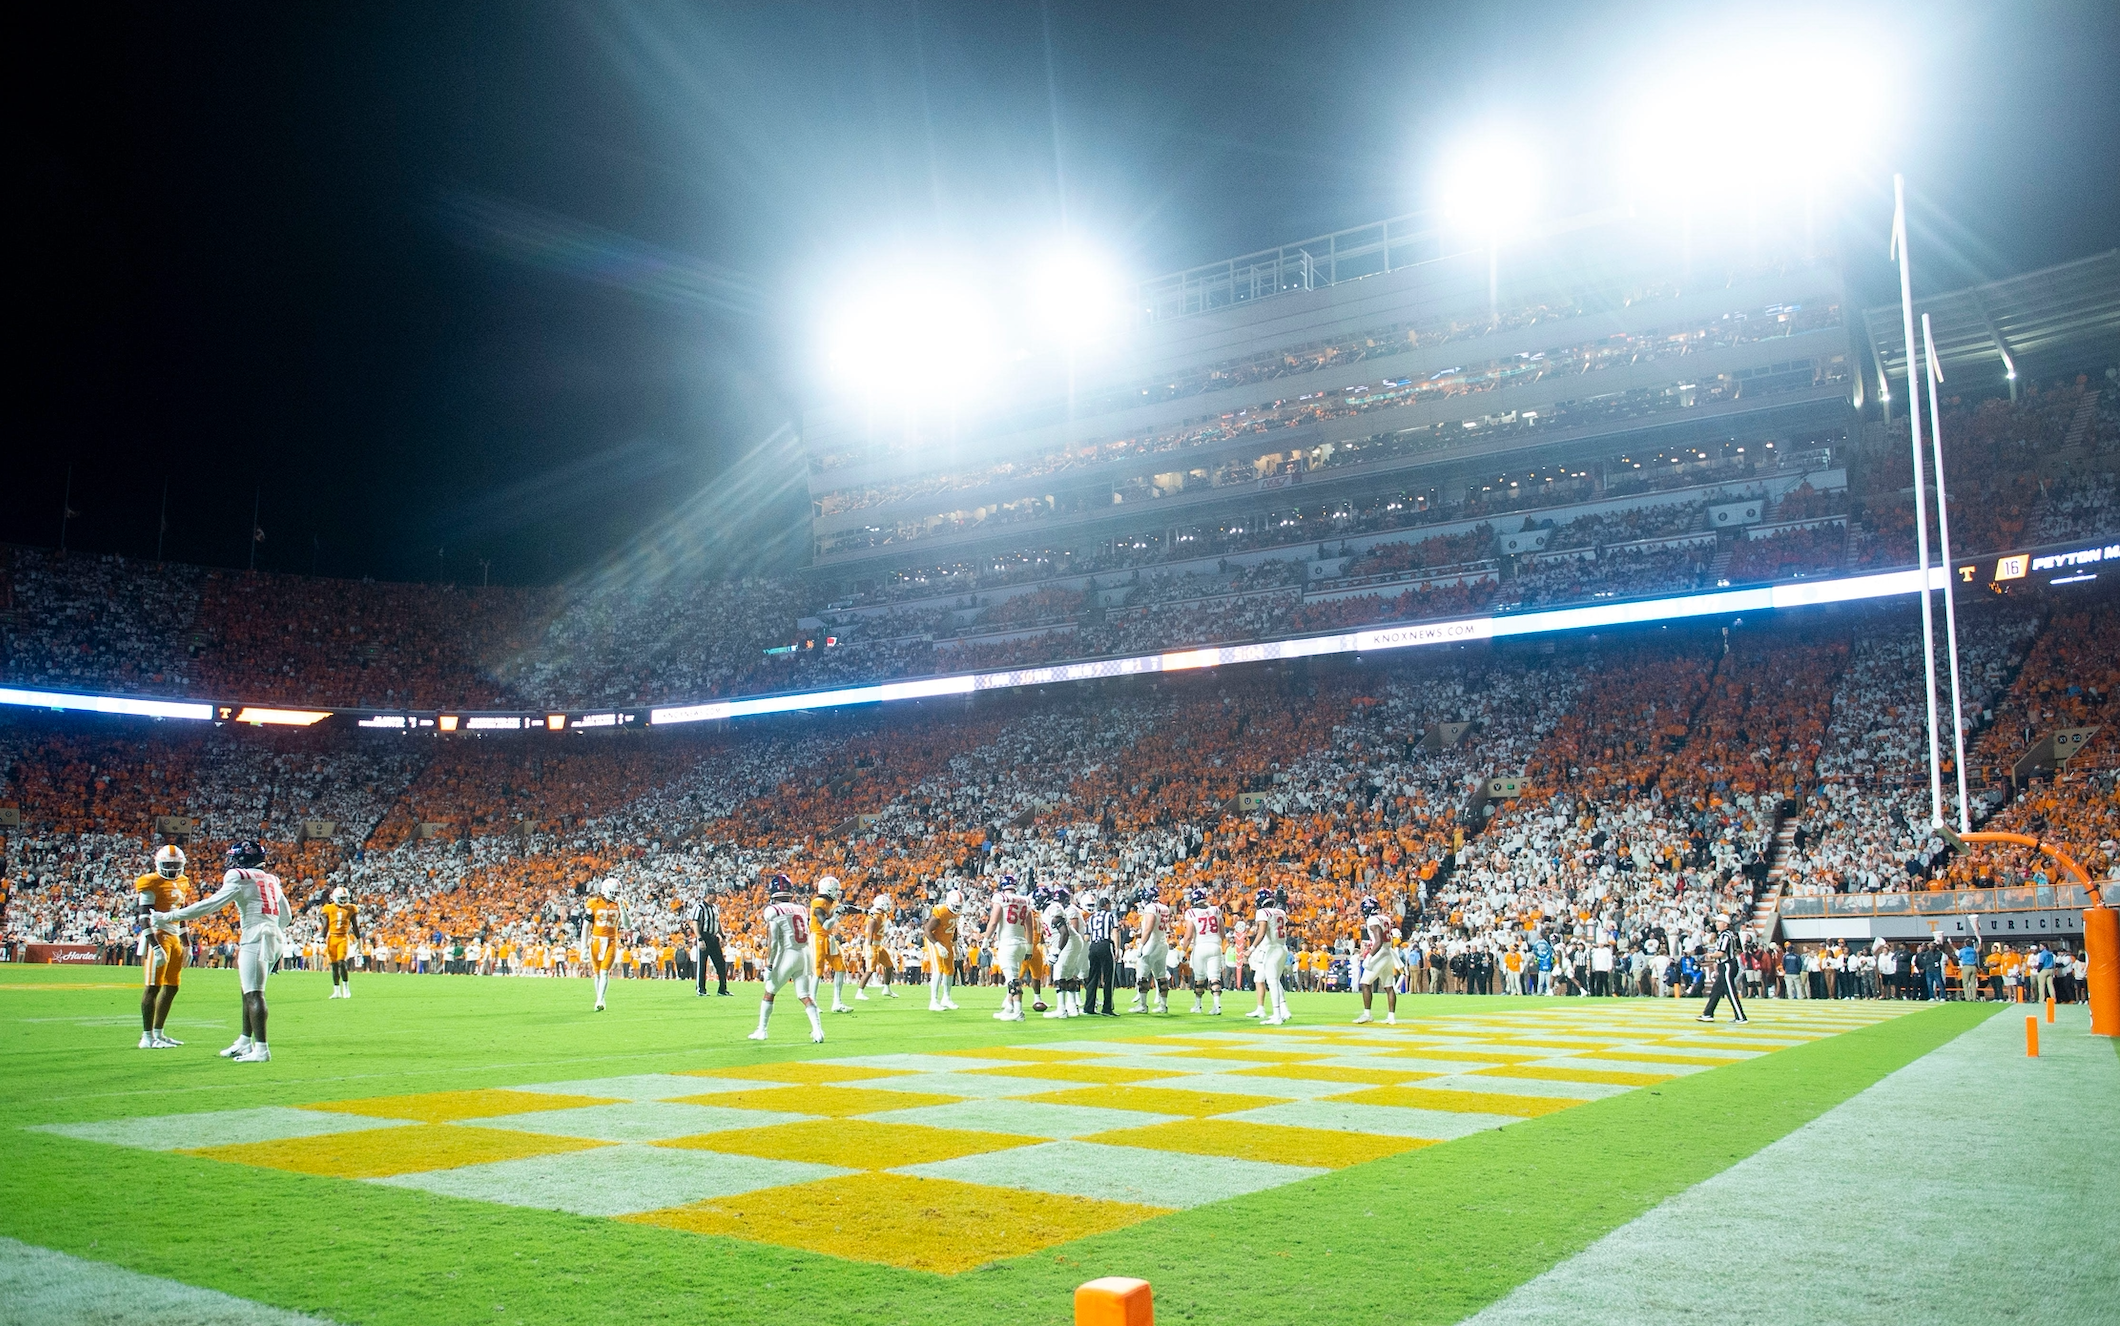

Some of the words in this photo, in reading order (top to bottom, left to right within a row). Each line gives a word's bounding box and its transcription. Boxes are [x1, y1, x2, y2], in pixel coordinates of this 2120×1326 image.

[2004, 560, 2019, 576] 16
[2032, 549, 2101, 571] PEYTON
[1958, 565, 1976, 582] T
[1373, 625, 1475, 644] KNOXNEWS.COM
[219, 706, 232, 720] T
[256, 880, 280, 916] 11
[336, 911, 343, 929] 1
[596, 908, 620, 928] 33
[1006, 904, 1028, 926] 64
[1198, 915, 1219, 935] 78
[1926, 920, 1940, 932] T
[1956, 917, 2083, 931] LURICEL
[792, 914, 808, 944] 0
[1276, 916, 1286, 939] 2
